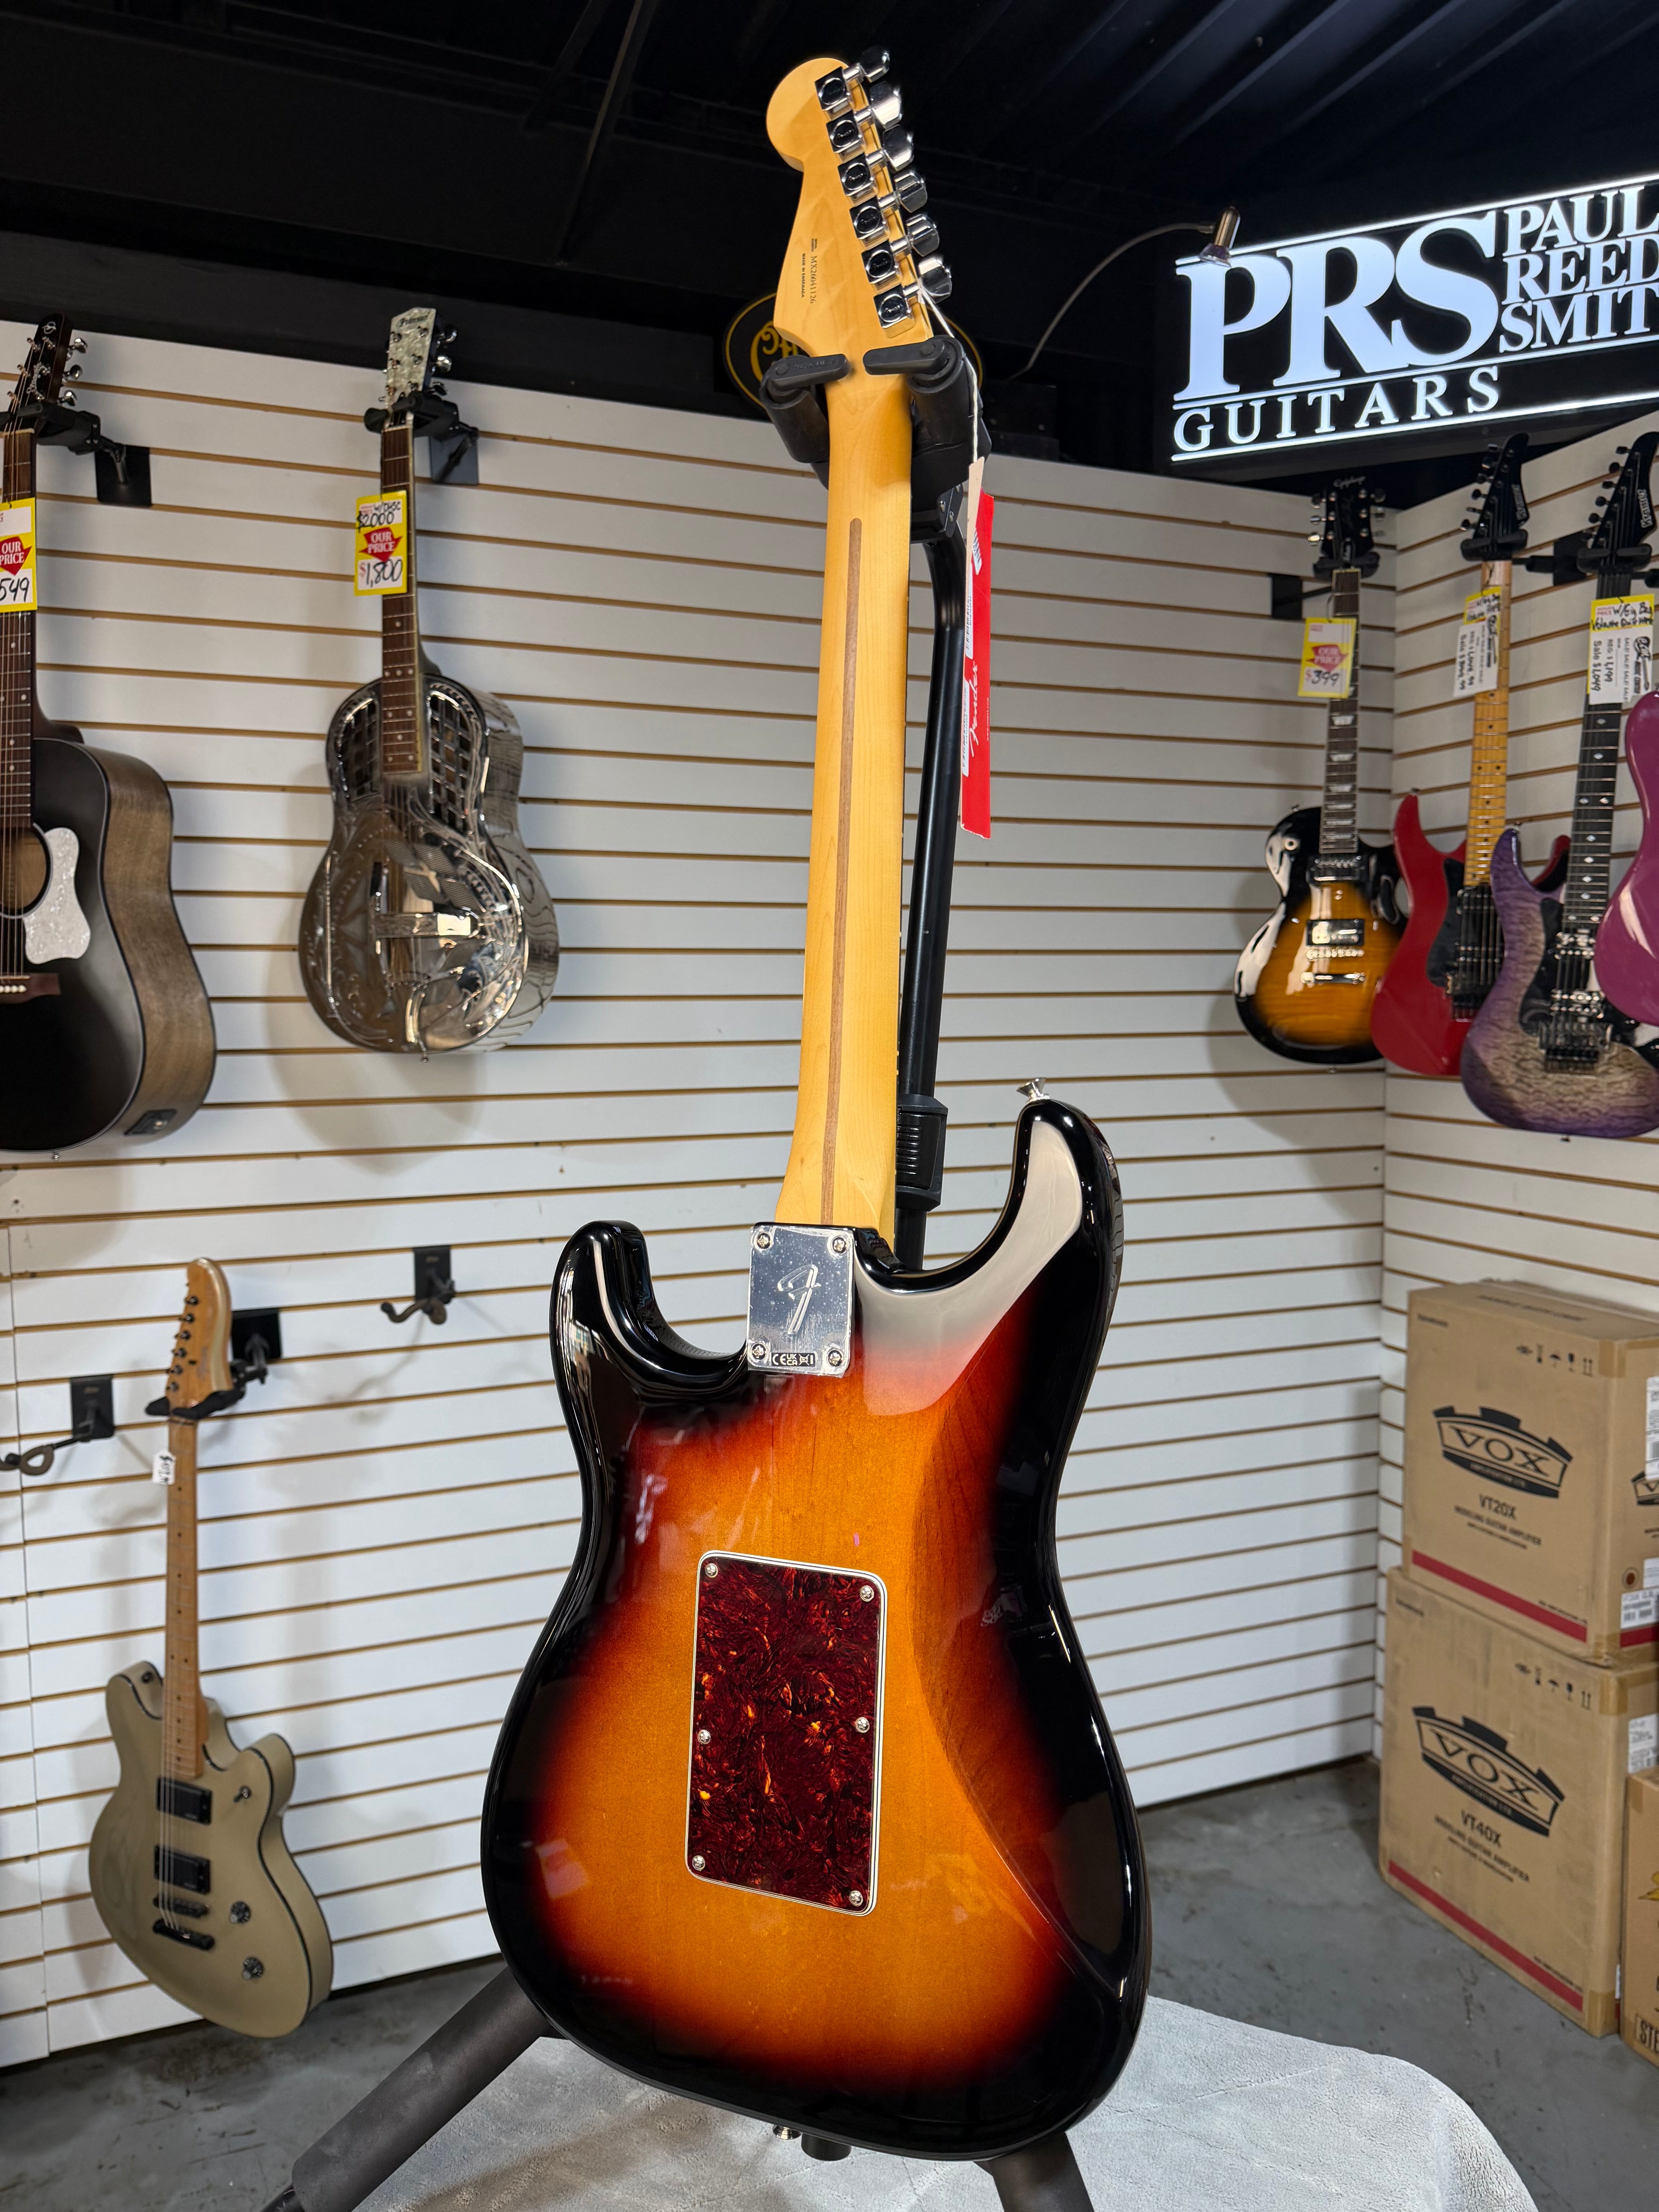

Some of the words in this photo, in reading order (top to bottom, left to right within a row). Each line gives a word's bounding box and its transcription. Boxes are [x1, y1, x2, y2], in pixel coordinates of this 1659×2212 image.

[1502, 185, 1659, 257] PAUL
[1502, 234, 1659, 305] REED
[1174, 211, 1498, 400] PRS
[1173, 366, 1499, 452] GUITARS
[1, 541, 21, 555] OUR
[368, 541, 396, 554] PRICE
[370, 531, 392, 543] OUR
[1592, 640, 1602, 661] Sale
[969, 664, 979, 757] Fender
[1448, 1424, 1551, 1477] VOX
[1479, 1493, 1517, 1521] VT20X
[1429, 1728, 1540, 1812] VOX
[1461, 1809, 1501, 1848] VT40X
